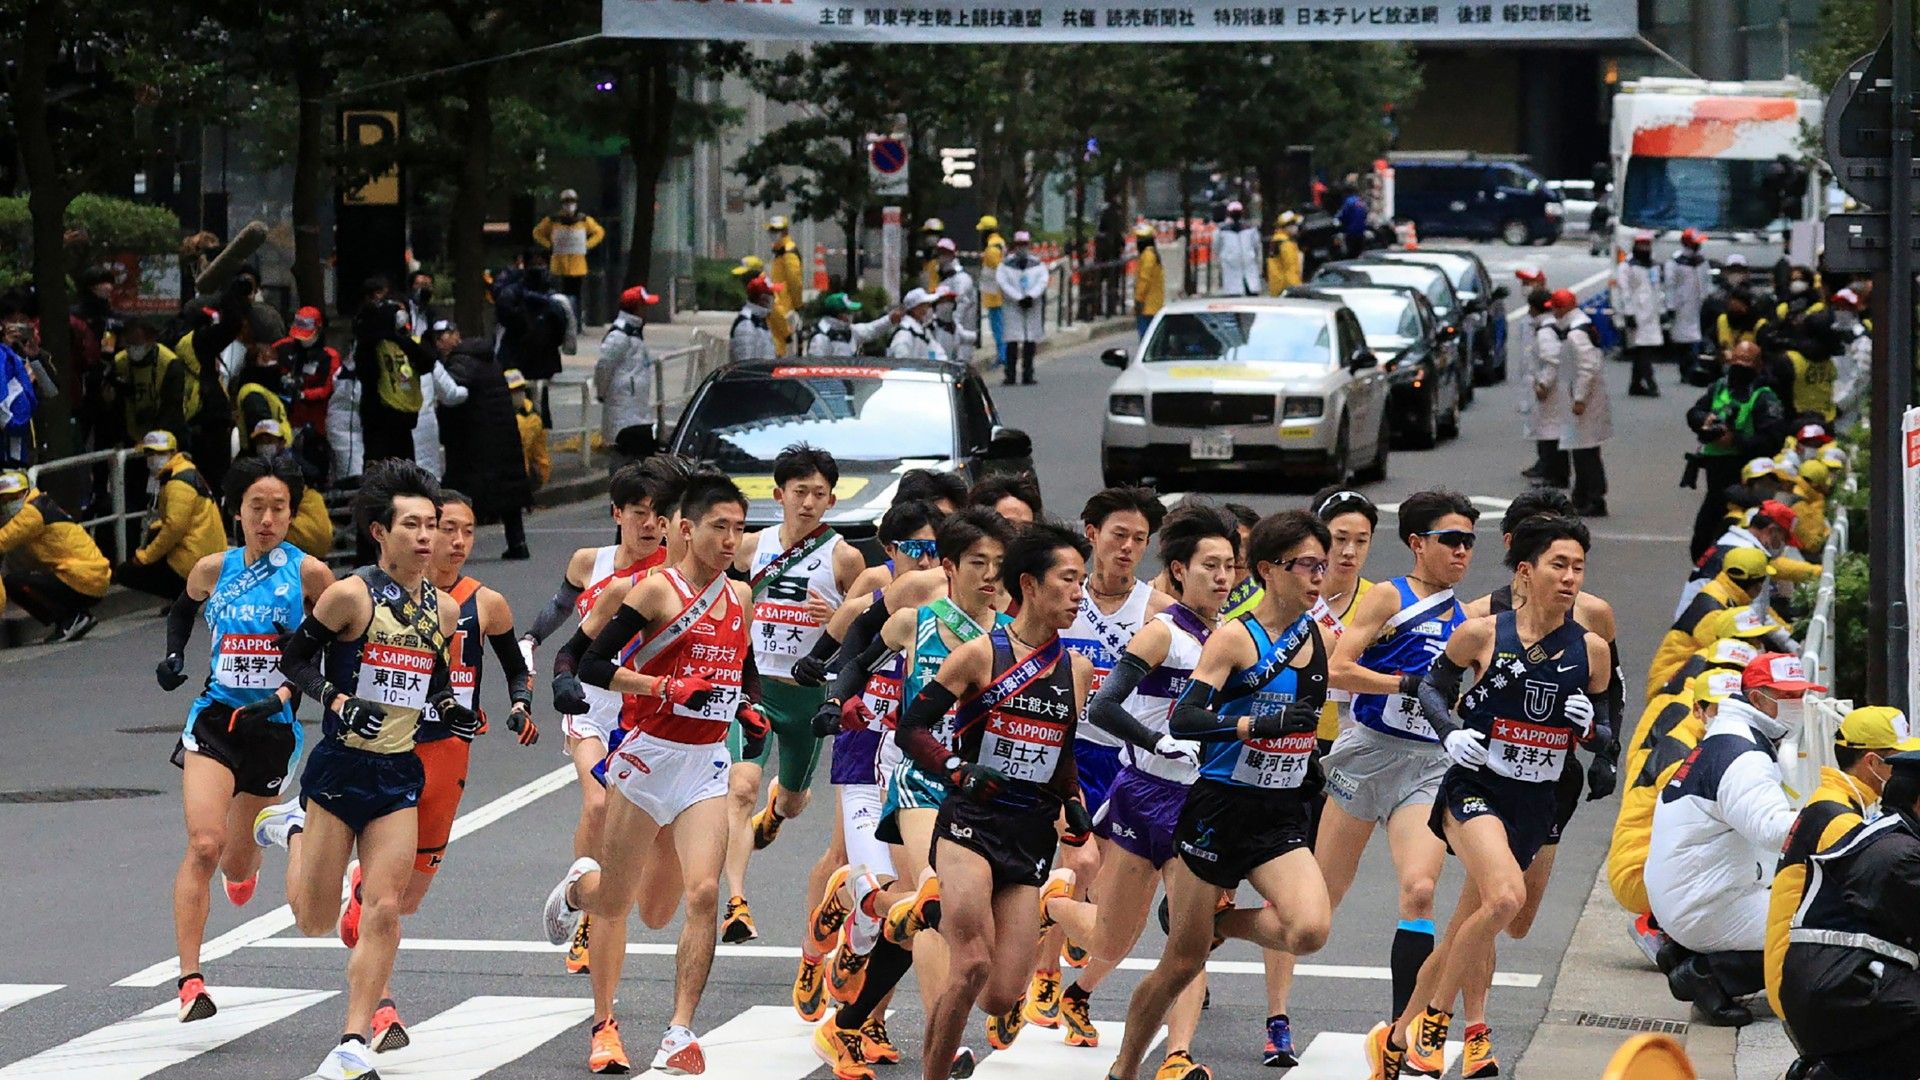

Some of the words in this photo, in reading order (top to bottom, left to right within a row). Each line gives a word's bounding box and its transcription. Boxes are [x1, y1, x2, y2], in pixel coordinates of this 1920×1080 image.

[819, 7, 854, 25] 主催
[864, 8, 1042, 27] 関東学生陸上競技連盟
[1062, 8, 1096, 28] 共催
[1106, 8, 1195, 28] 読売新聞社
[1214, 7, 1284, 26] 特別後援
[1297, 6, 1439, 25] 日本テレビ放送網
[1458, 4, 1492, 23] 後援
[1503, 3, 1592, 22] 報知新聞社
[810, 367, 882, 375] TOYOTA
[220, 604, 290, 625] 山梨学院
[231, 638, 279, 651] SAPPO
[763, 640, 798, 655] 19-13
[381, 651, 433, 670] SAPPORO
[234, 674, 266, 687] 14-1
[373, 669, 421, 692] 東国大
[383, 689, 411, 706] 10-1
[709, 685, 738, 704] 京大
[703, 704, 727, 719] 8-1
[1008, 721, 1064, 743] SAPPORO
[1512, 727, 1569, 745] SAPPORO
[993, 738, 1048, 765] 国士大
[1502, 744, 1556, 768] 東洋大
[1001, 760, 1033, 778] 20-1
[1514, 765, 1539, 780] 3-1
[1256, 772, 1291, 787] 18-12
